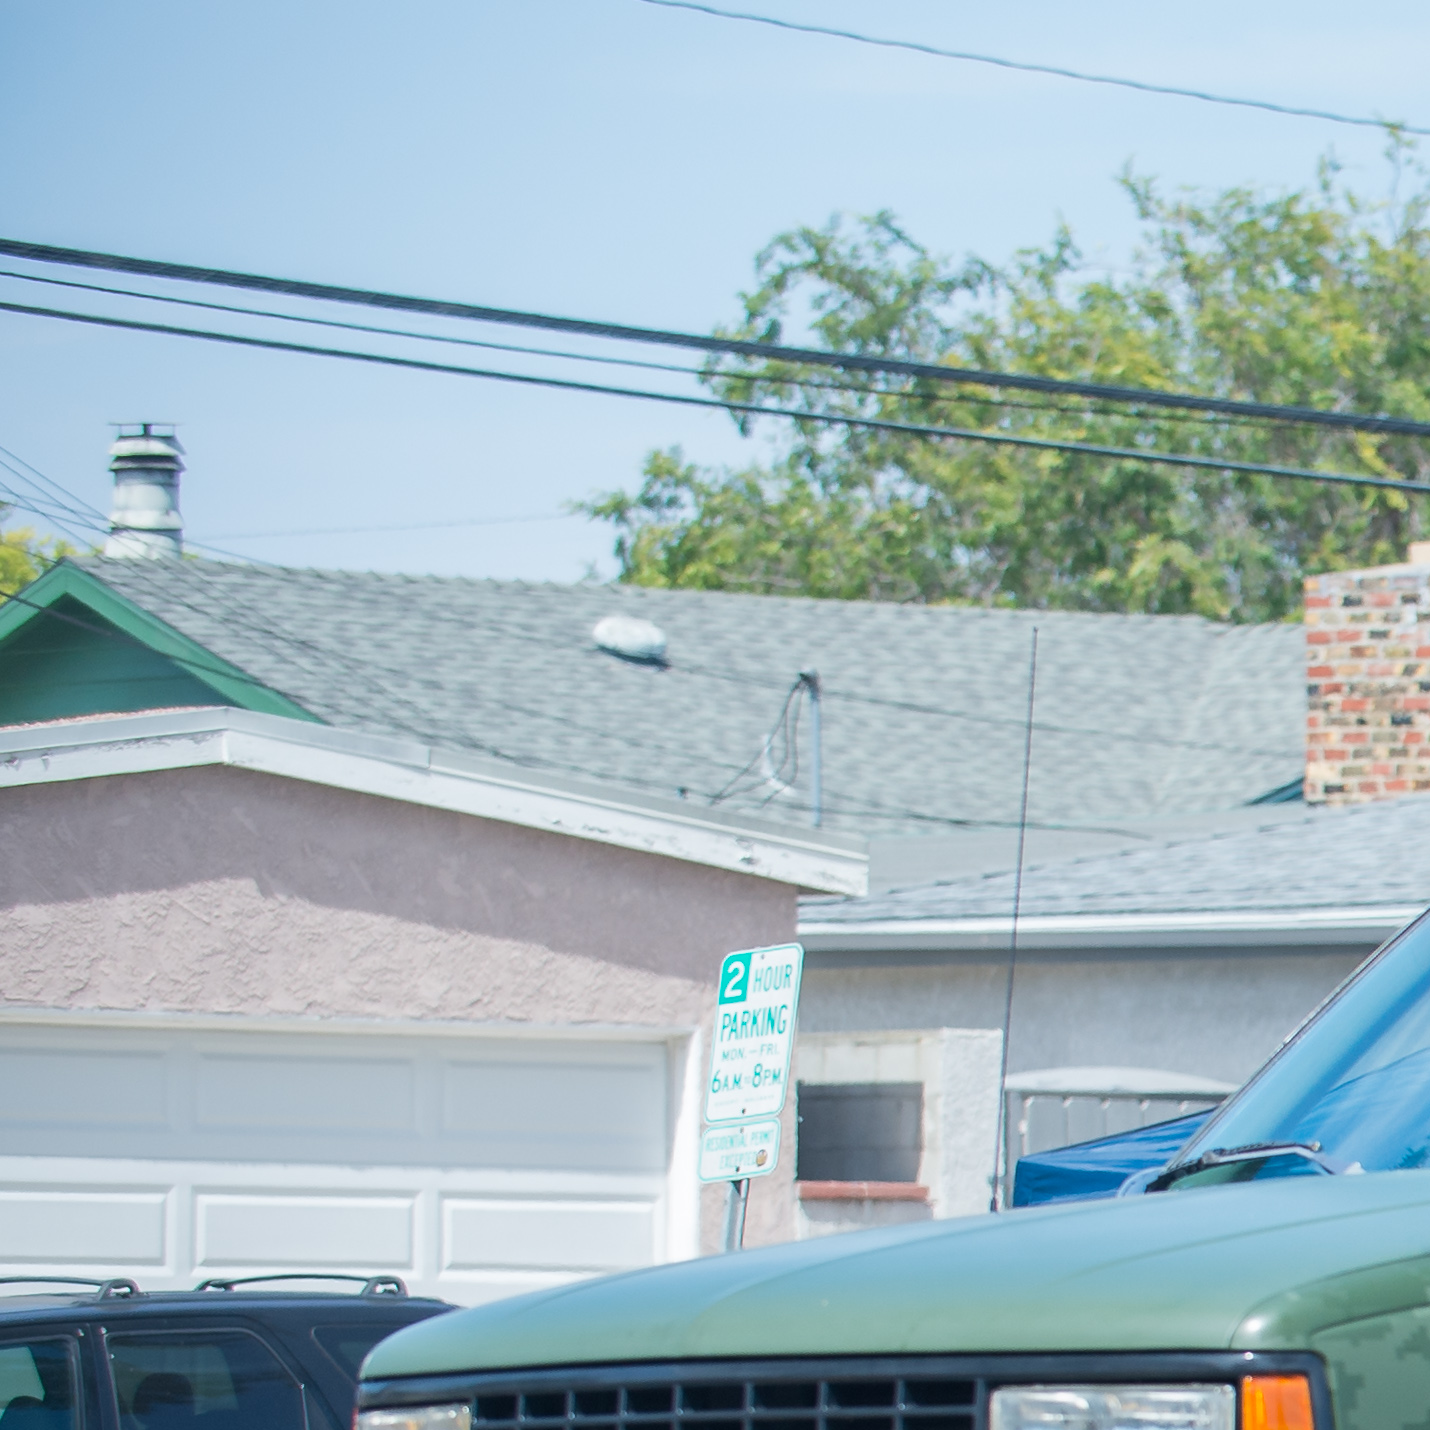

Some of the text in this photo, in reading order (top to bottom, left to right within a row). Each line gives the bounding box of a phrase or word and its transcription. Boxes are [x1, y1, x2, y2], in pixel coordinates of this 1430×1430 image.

[723, 960, 793, 998] 2 HOUR
[720, 1004, 788, 1042] PARKING
